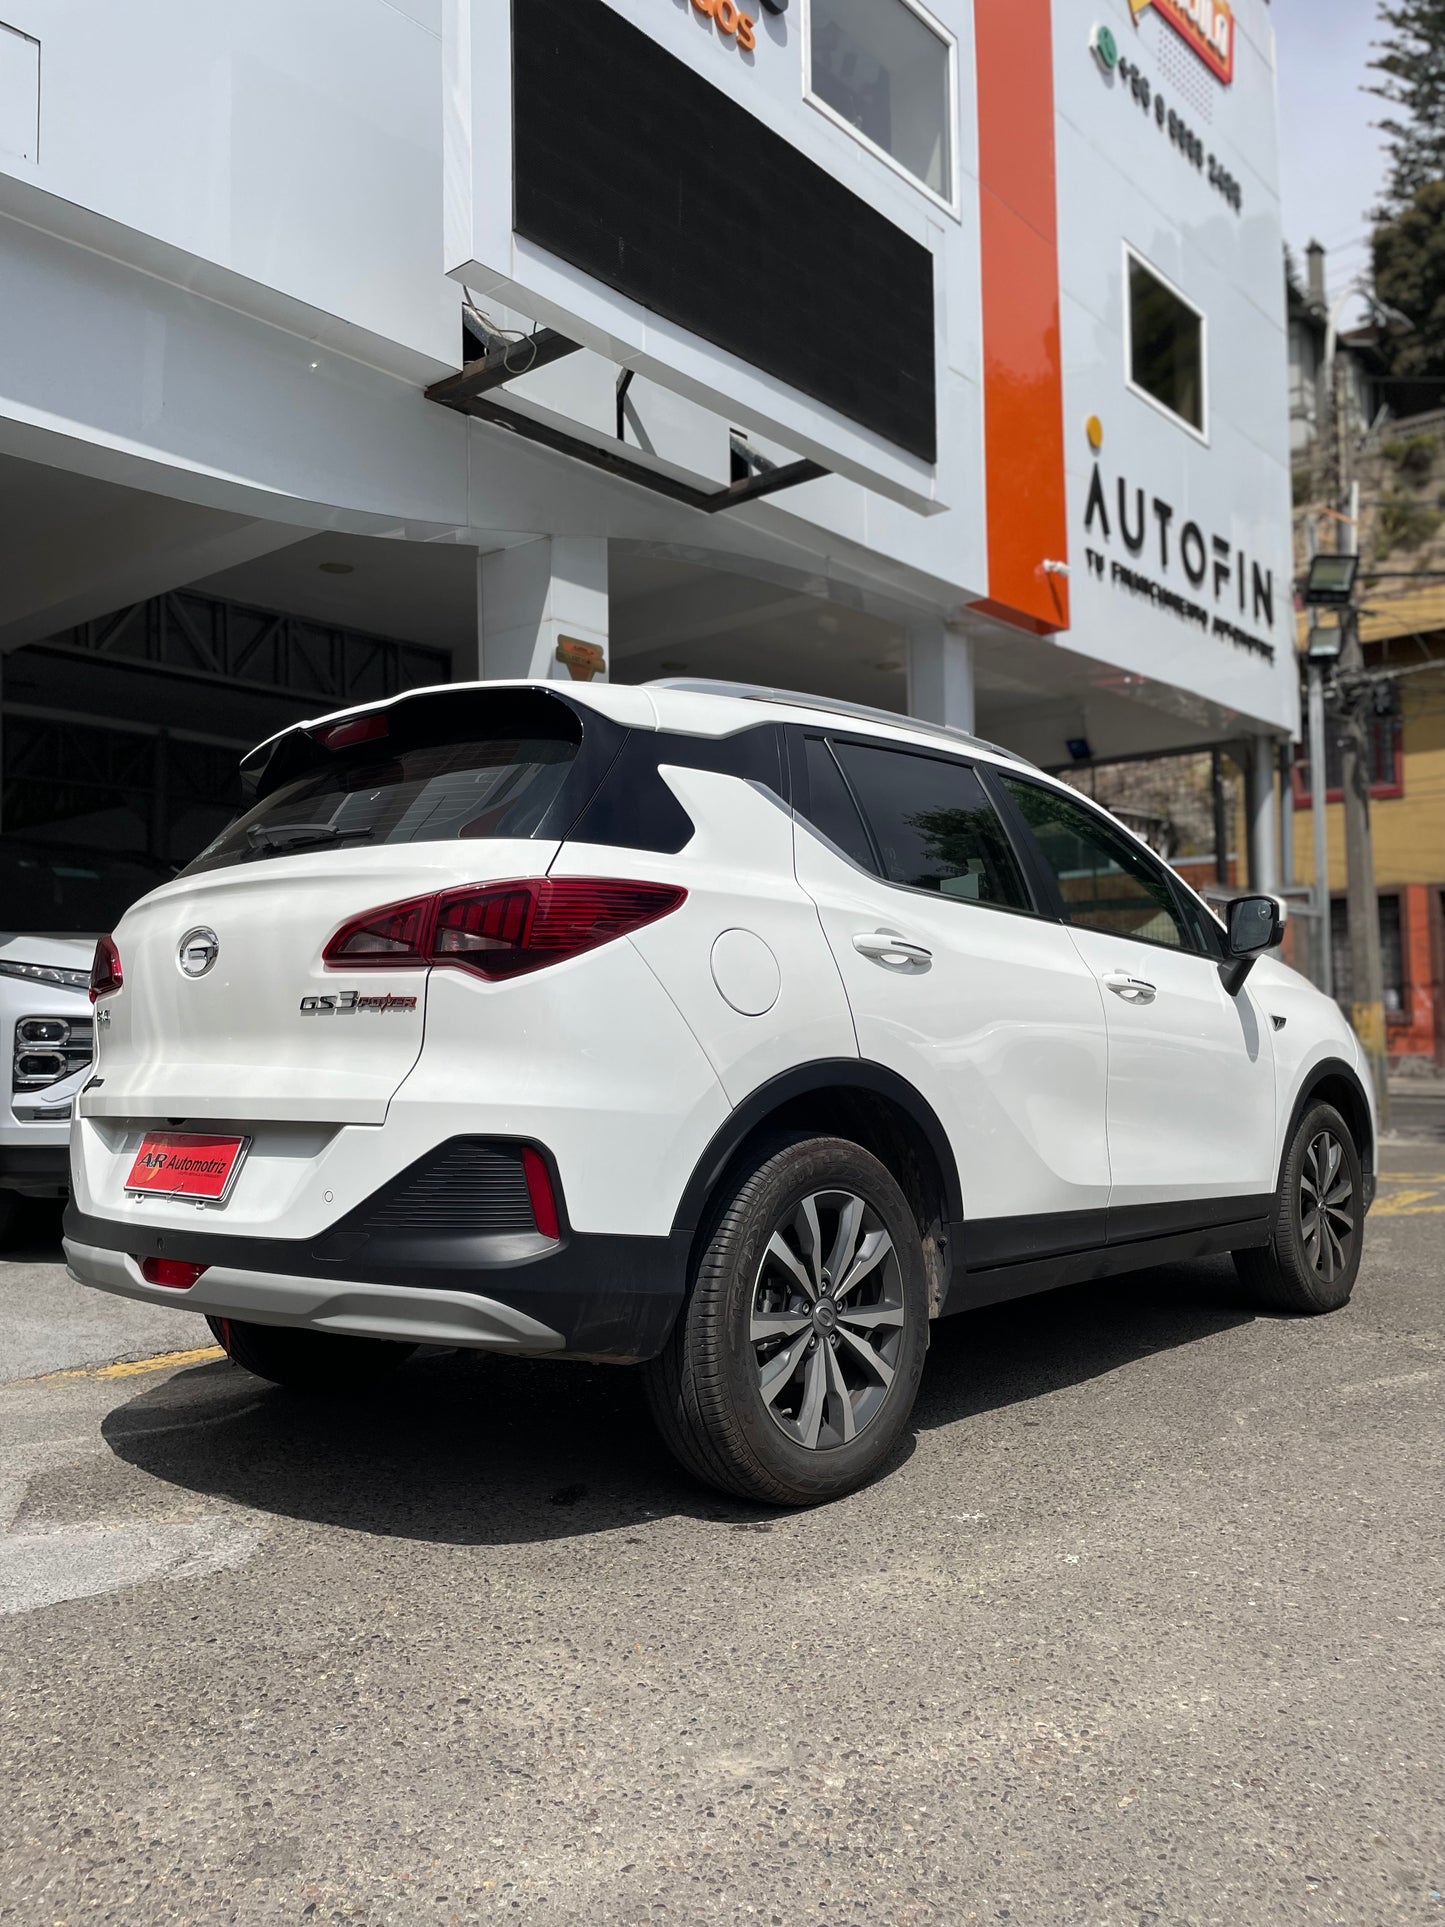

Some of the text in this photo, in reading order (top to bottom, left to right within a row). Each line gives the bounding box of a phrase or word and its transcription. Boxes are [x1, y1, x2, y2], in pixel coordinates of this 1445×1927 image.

[1084, 461, 1273, 626] AUTOFIN
[1086, 548, 1105, 574] TU
[299, 990, 418, 1014] GS3 POWER
[166, 1154, 227, 1175] Automotriz
